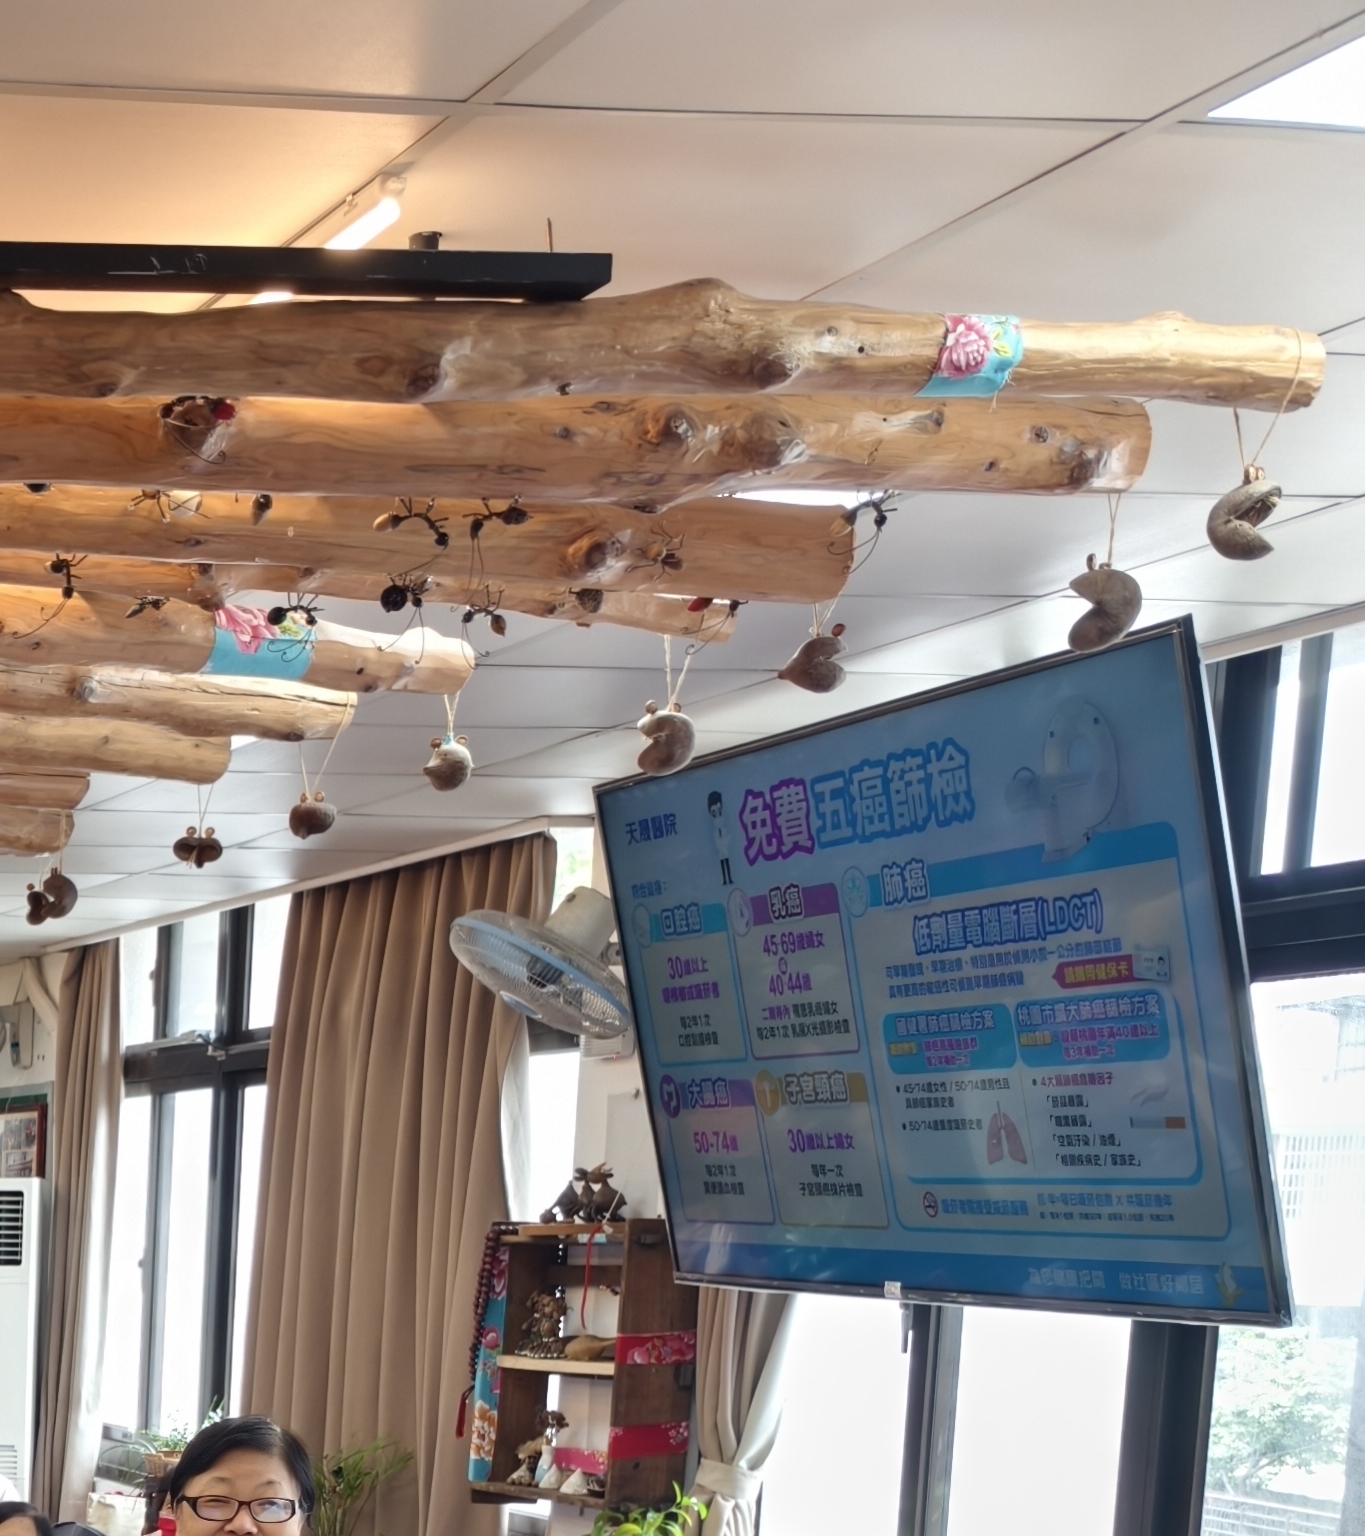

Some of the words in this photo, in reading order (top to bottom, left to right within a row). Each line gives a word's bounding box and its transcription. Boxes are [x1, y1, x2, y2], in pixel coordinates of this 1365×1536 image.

[739, 740, 974, 866] 免費五癌篩檢
[769, 883, 804, 920] 乳癌
[881, 858, 929, 905] 肺癌
[662, 903, 702, 936] 口腔癌
[913, 888, 1104, 955] 低劑量電腦斷層(LDCT)
[783, 1069, 849, 1106] 子宮頸癌
